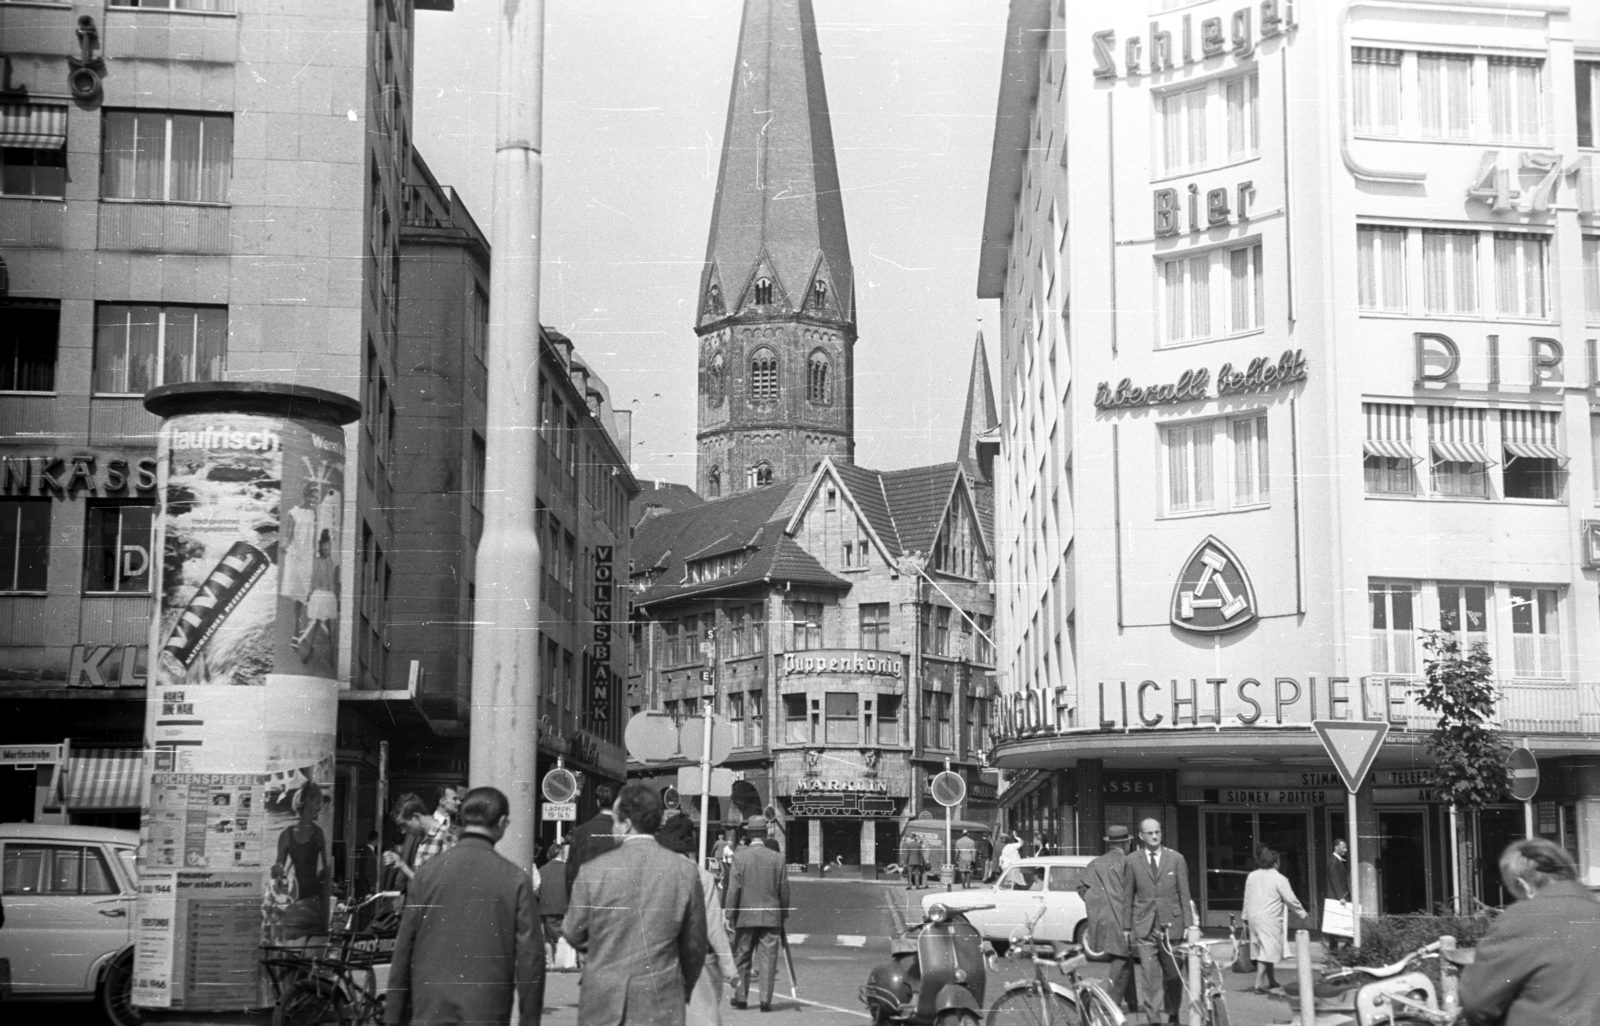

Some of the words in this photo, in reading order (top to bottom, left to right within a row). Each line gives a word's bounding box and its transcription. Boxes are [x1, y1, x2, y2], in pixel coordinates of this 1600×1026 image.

[1153, 180, 1254, 236] Bier
[1094, 367, 1210, 408] überall
[1217, 349, 1306, 396] beliebt
[166, 553, 254, 649] VIVIL
[595, 547, 610, 719] VOLKSBANK
[783, 652, 901, 678] Puppenkönig
[1099, 677, 1408, 728] LICHTSPIELE
[156, 774, 260, 785] WOCHENSPIEGEL
[1146, 781, 1154, 793] 1
[1227, 790, 1269, 803] SIDNEY
[1279, 790, 1326, 803] POITIER
[176, 881, 192, 889] der
[194, 881, 222, 889] stadt
[224, 881, 253, 889] bonn
